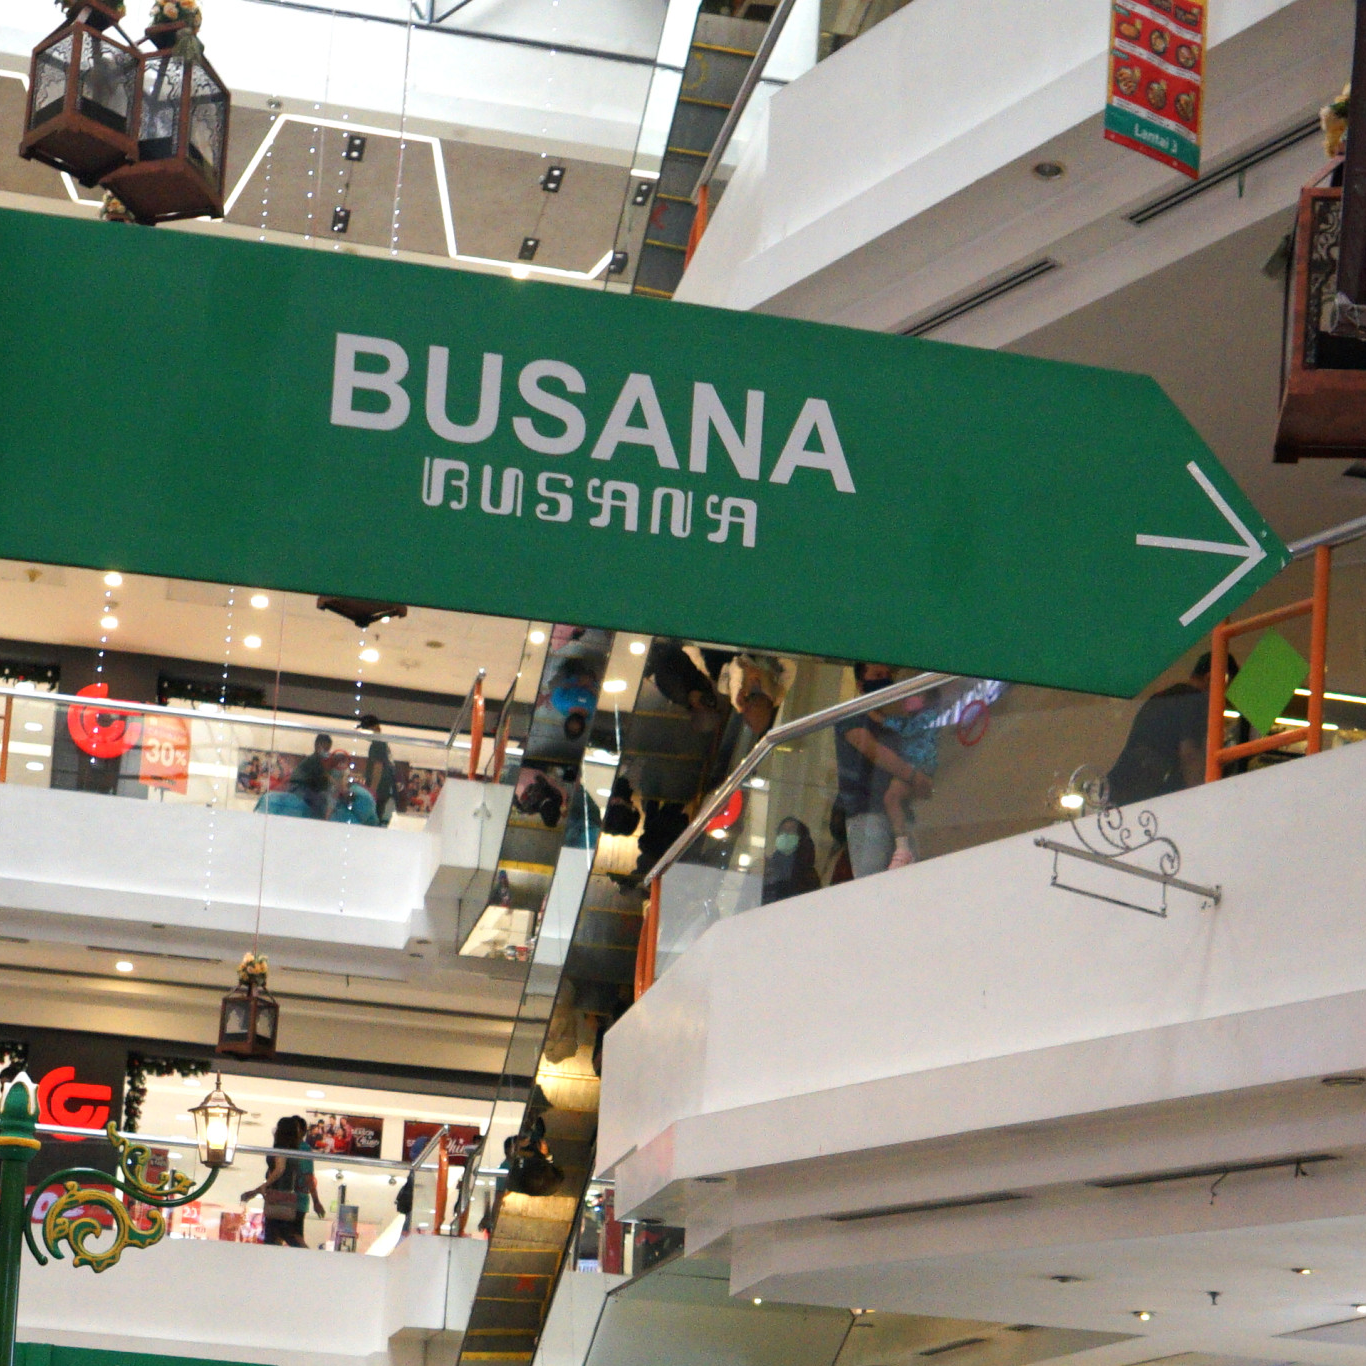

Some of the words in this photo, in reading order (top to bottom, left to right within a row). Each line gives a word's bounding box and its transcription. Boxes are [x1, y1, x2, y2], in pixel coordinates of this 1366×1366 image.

[330, 332, 857, 494] BUSANA
[421, 456, 759, 548] BUSANA
[145, 738, 187, 767] 30%
